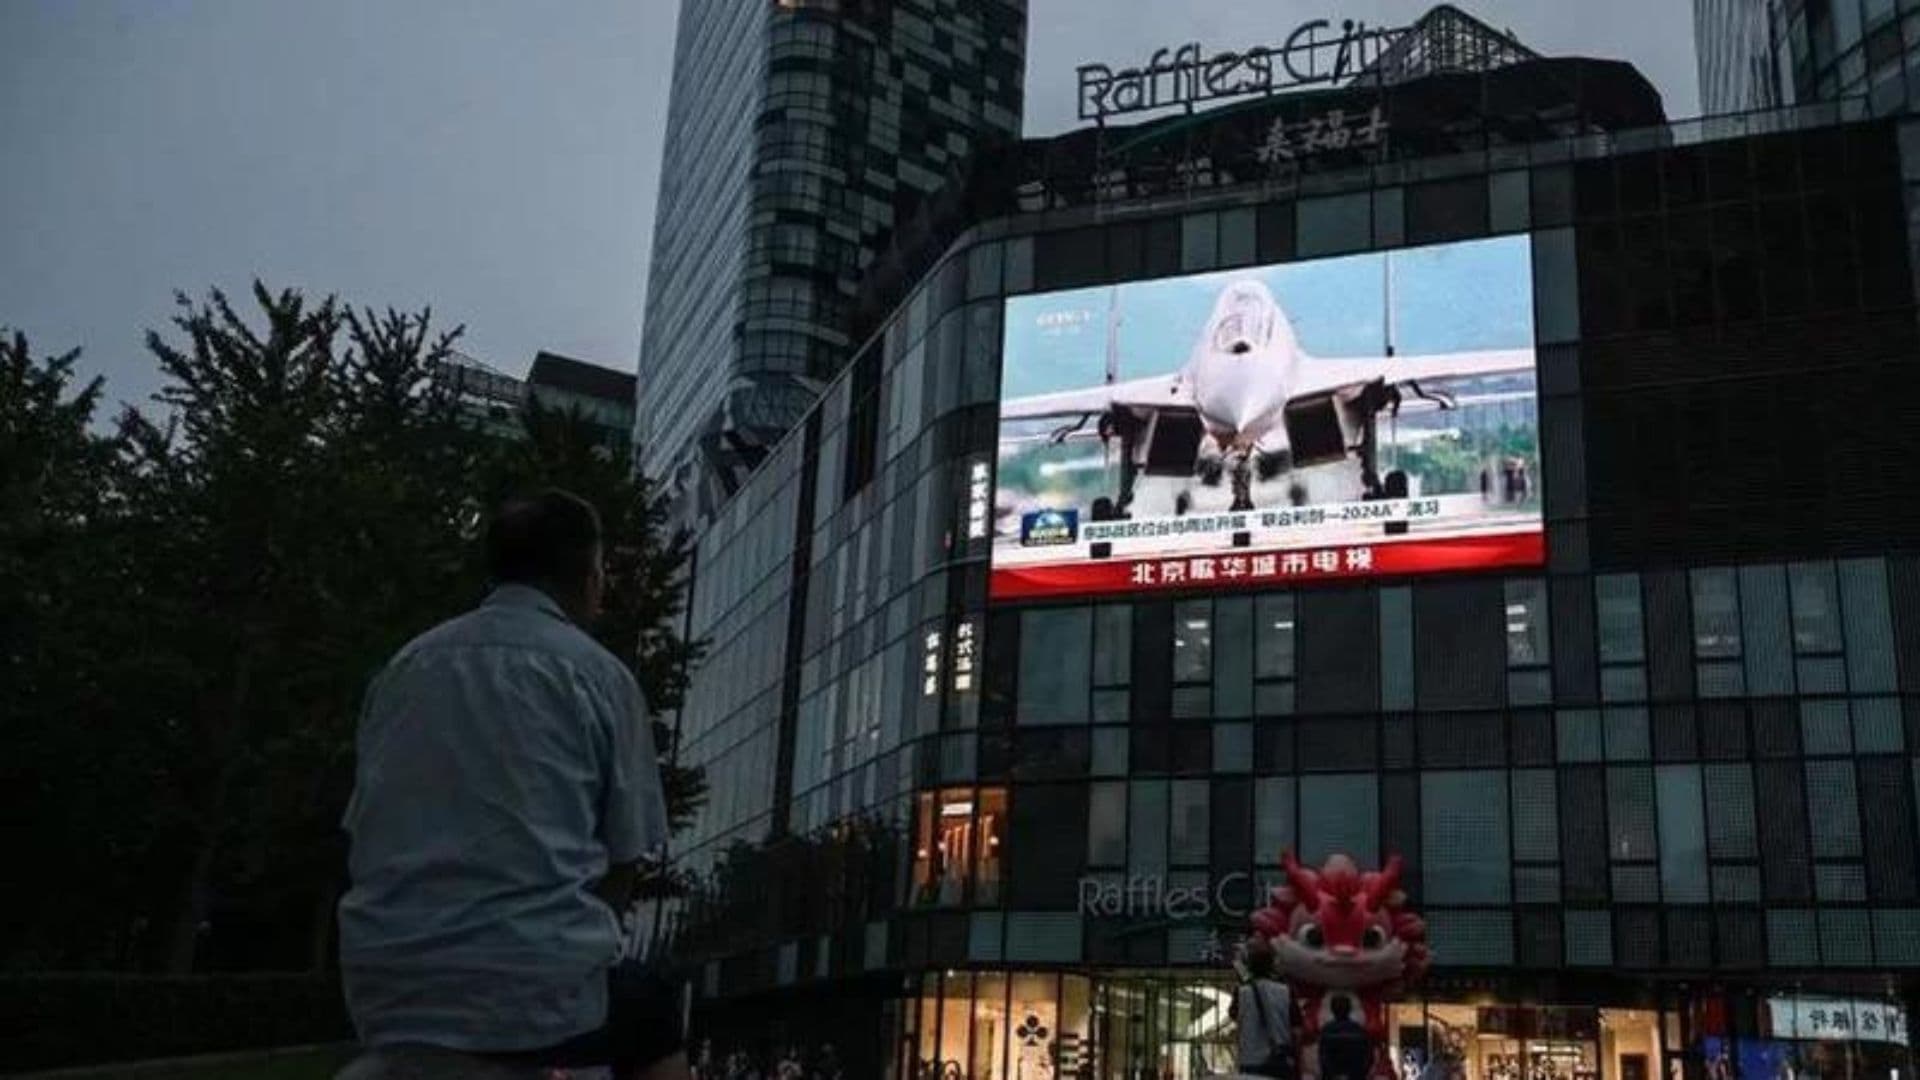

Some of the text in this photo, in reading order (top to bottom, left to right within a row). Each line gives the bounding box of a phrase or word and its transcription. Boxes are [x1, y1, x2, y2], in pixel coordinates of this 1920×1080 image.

[1076, 42, 1271, 119] Raffles
[1131, 546, 1374, 586] 北京歌华城市电视
[1078, 875, 1211, 919] Raffles
